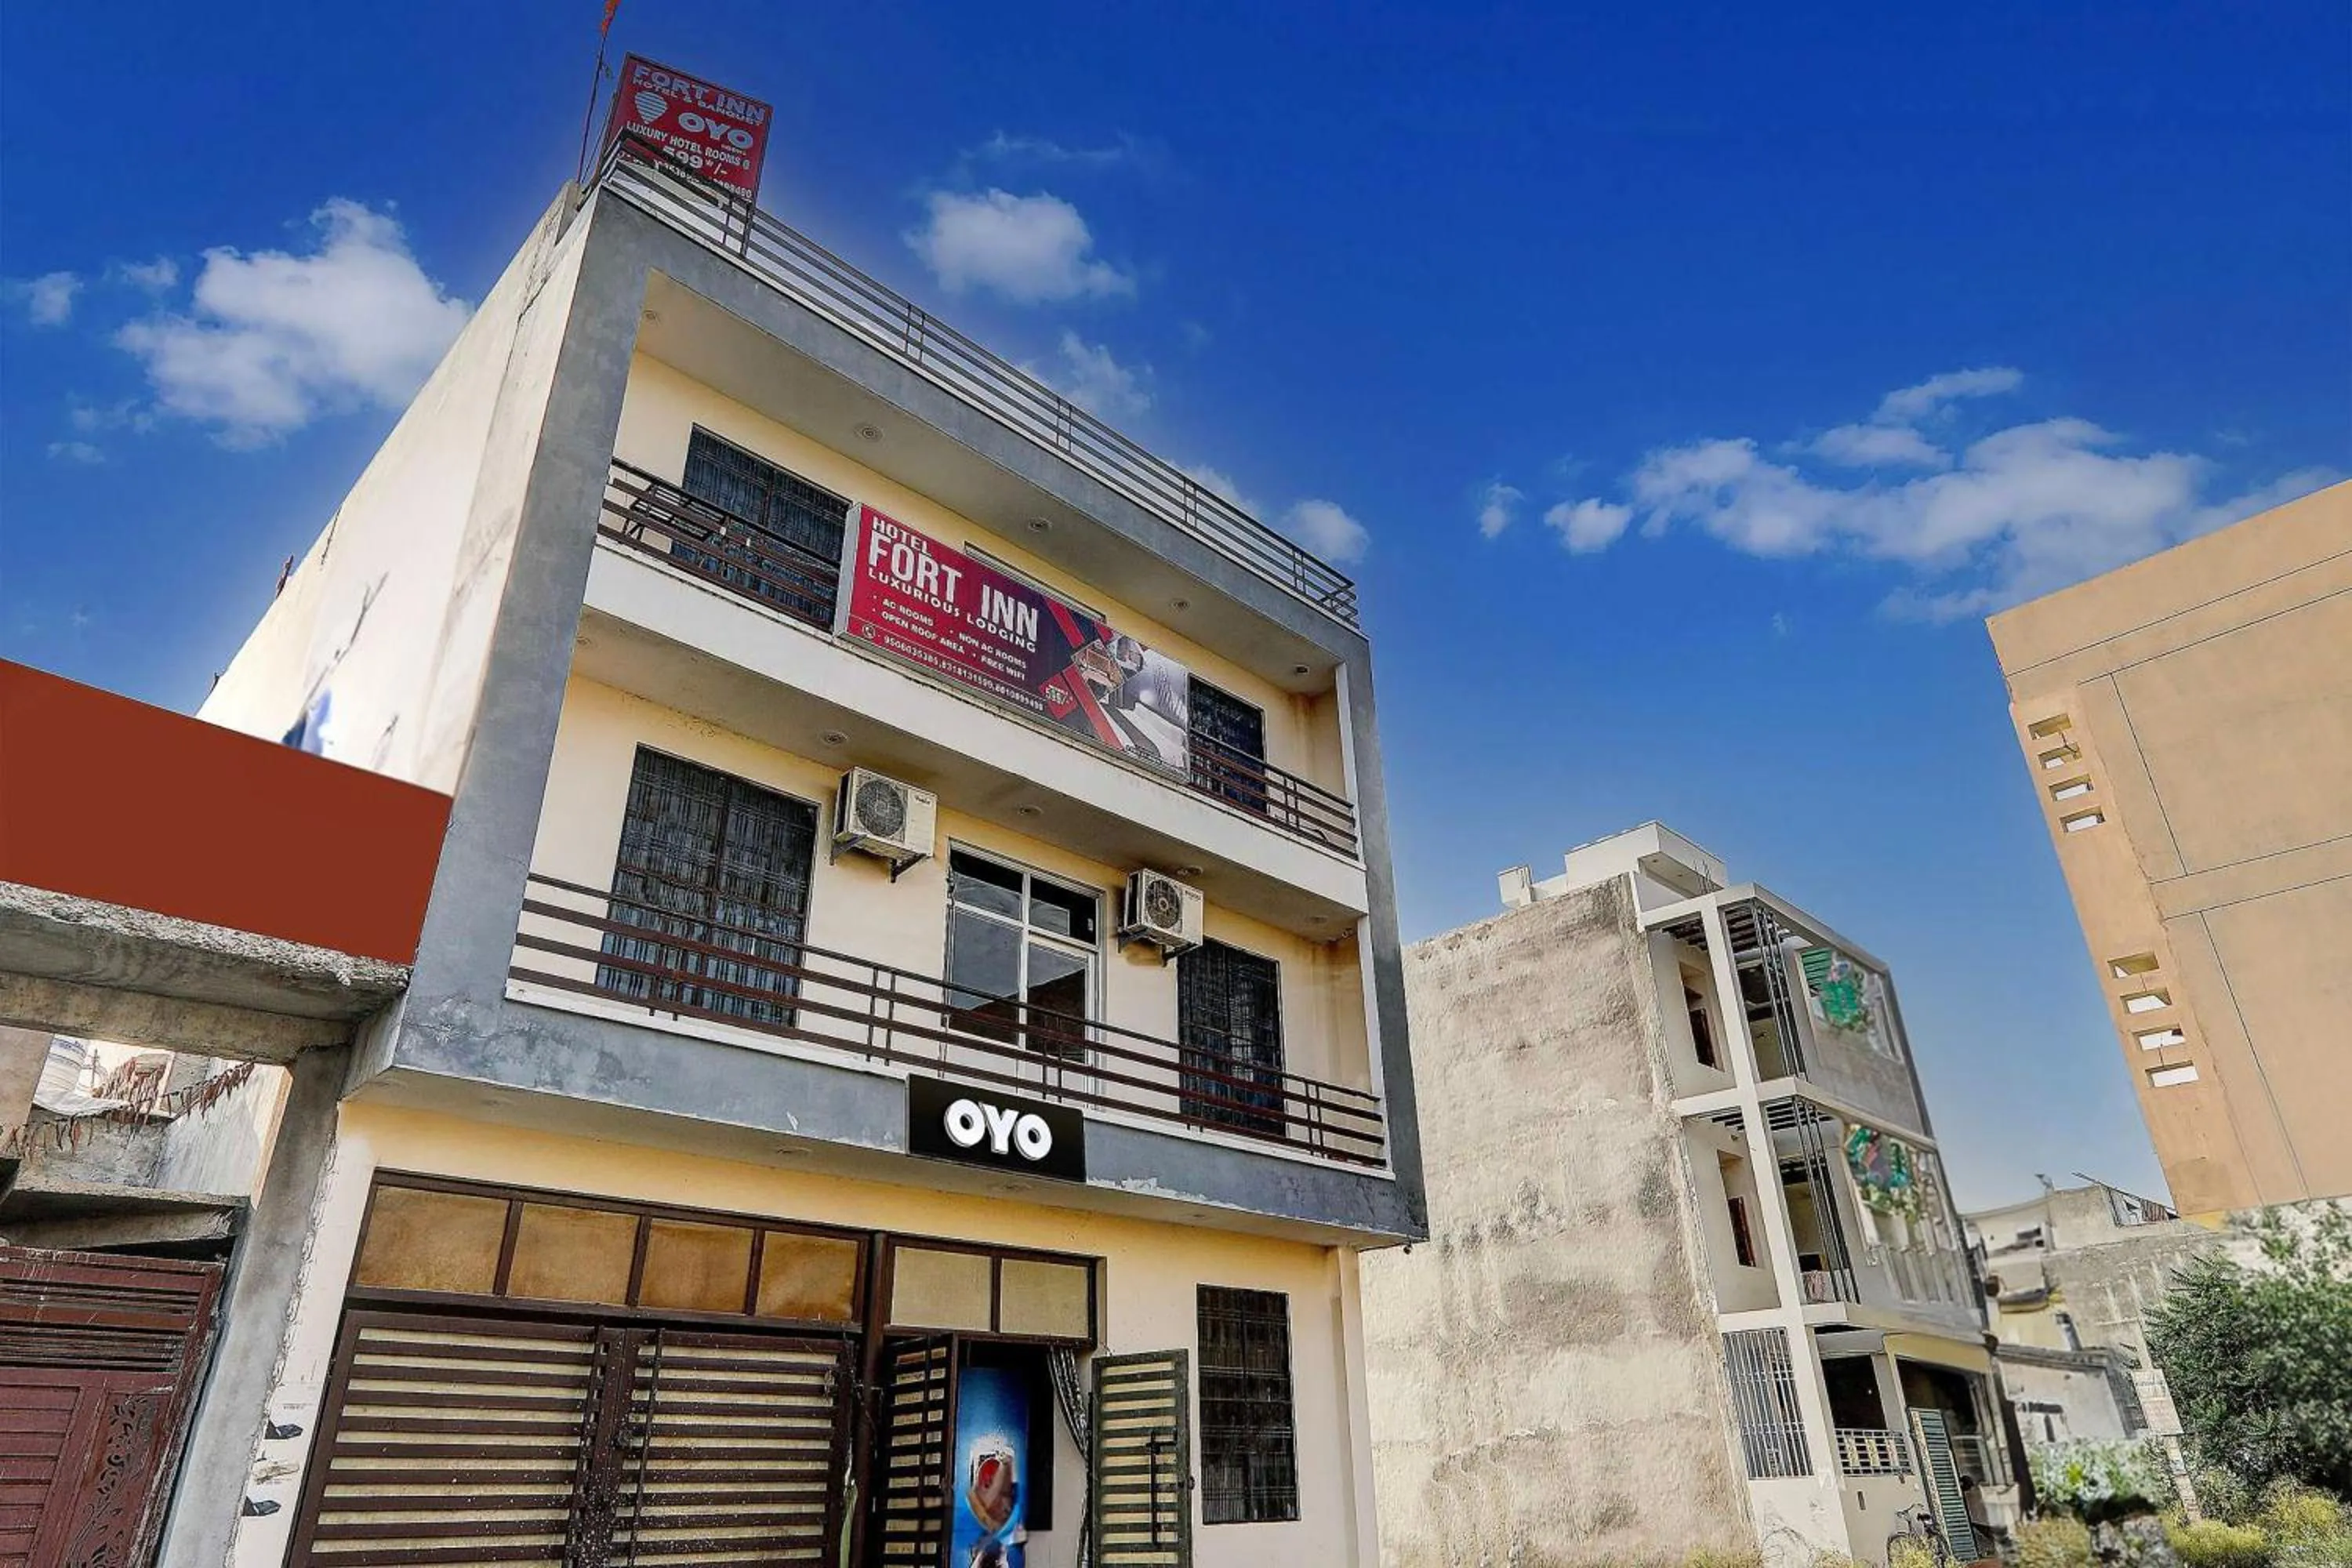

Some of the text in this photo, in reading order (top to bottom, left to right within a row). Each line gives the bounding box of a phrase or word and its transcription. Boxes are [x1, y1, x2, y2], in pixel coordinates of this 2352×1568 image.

[633, 64, 765, 121] FORT INN
[626, 121, 667, 142] LUXURY
[670, 135, 702, 154] HOTEL
[706, 147, 741, 165] ROOMS
[678, 112, 753, 149] OYO
[873, 516, 931, 556] HOTEL
[869, 529, 1039, 642] FORT INN
[869, 568, 1036, 653] LUXURIOUS LODGING
[882, 611, 909, 629] OPEN
[883, 598, 934, 626] AC ROOMS
[959, 632, 1026, 669] NON AC ROOMS
[1006, 668, 1025, 681] WIFI
[943, 1098, 1053, 1160] OYO
